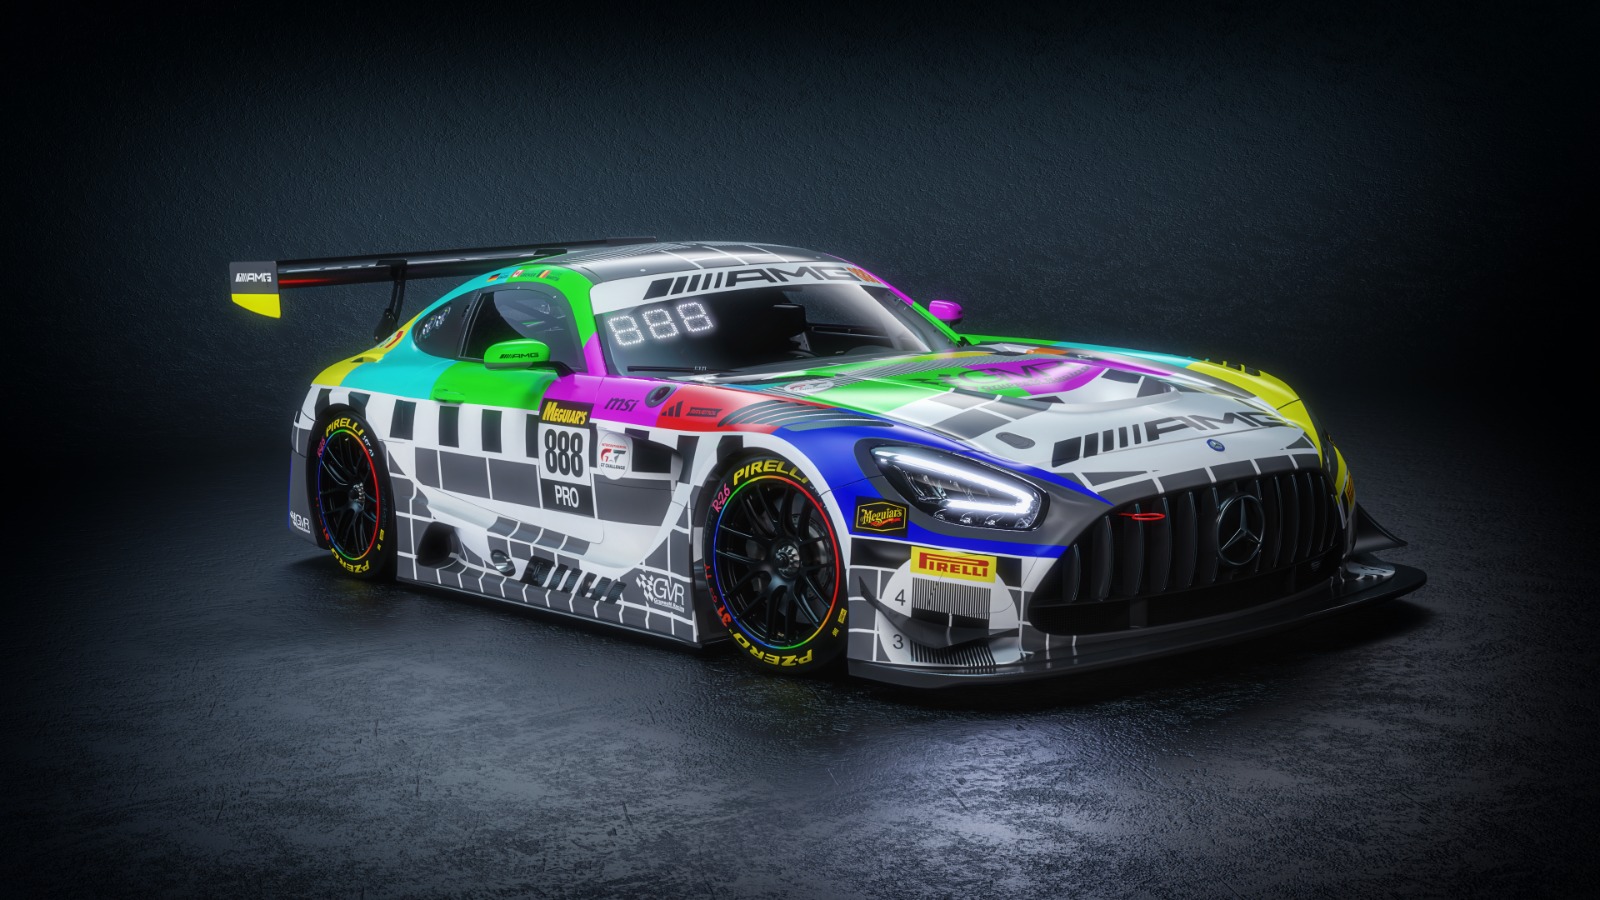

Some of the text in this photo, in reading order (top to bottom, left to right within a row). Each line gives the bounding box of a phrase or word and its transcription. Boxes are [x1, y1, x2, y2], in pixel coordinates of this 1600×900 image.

[725, 266, 861, 288] AMG
[608, 301, 714, 346] 888
[603, 397, 640, 413] msi
[326, 418, 364, 437] PIRELLI
[544, 428, 584, 478] 888
[733, 460, 810, 486] PIRELLI
[554, 485, 580, 508] PRO
[919, 552, 989, 577] PIRELLI
[894, 588, 906, 606] 4
[892, 633, 904, 650] 3
